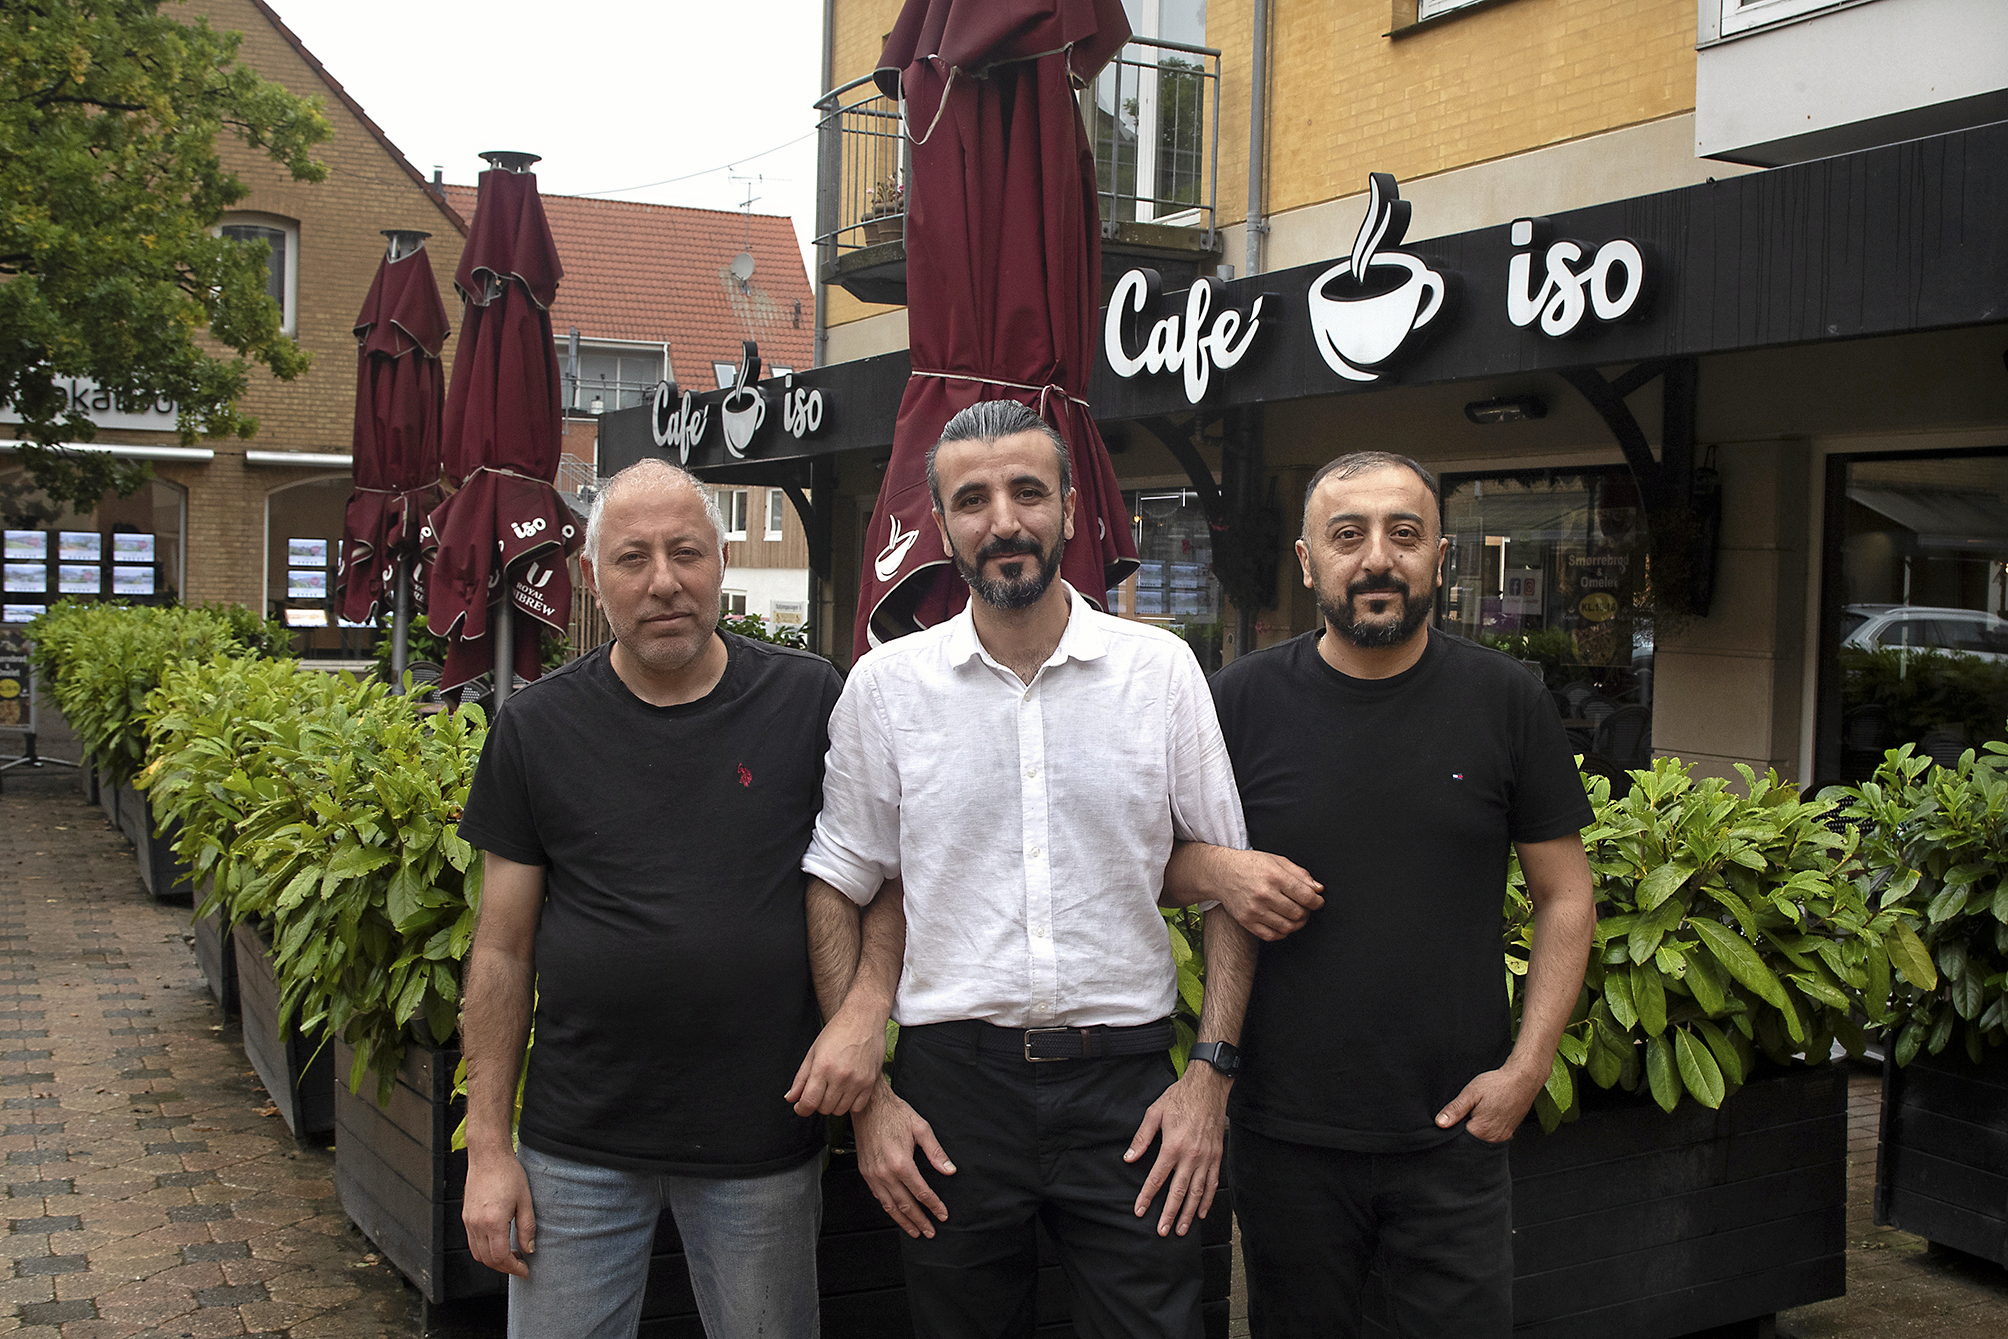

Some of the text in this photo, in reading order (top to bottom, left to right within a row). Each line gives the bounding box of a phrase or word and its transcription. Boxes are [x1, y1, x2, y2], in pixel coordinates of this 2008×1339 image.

[1507, 220, 1643, 337] iso
[784, 374, 823, 438] iso
[511, 517, 547, 539] iso
[516, 582, 544, 601] ROYAL
